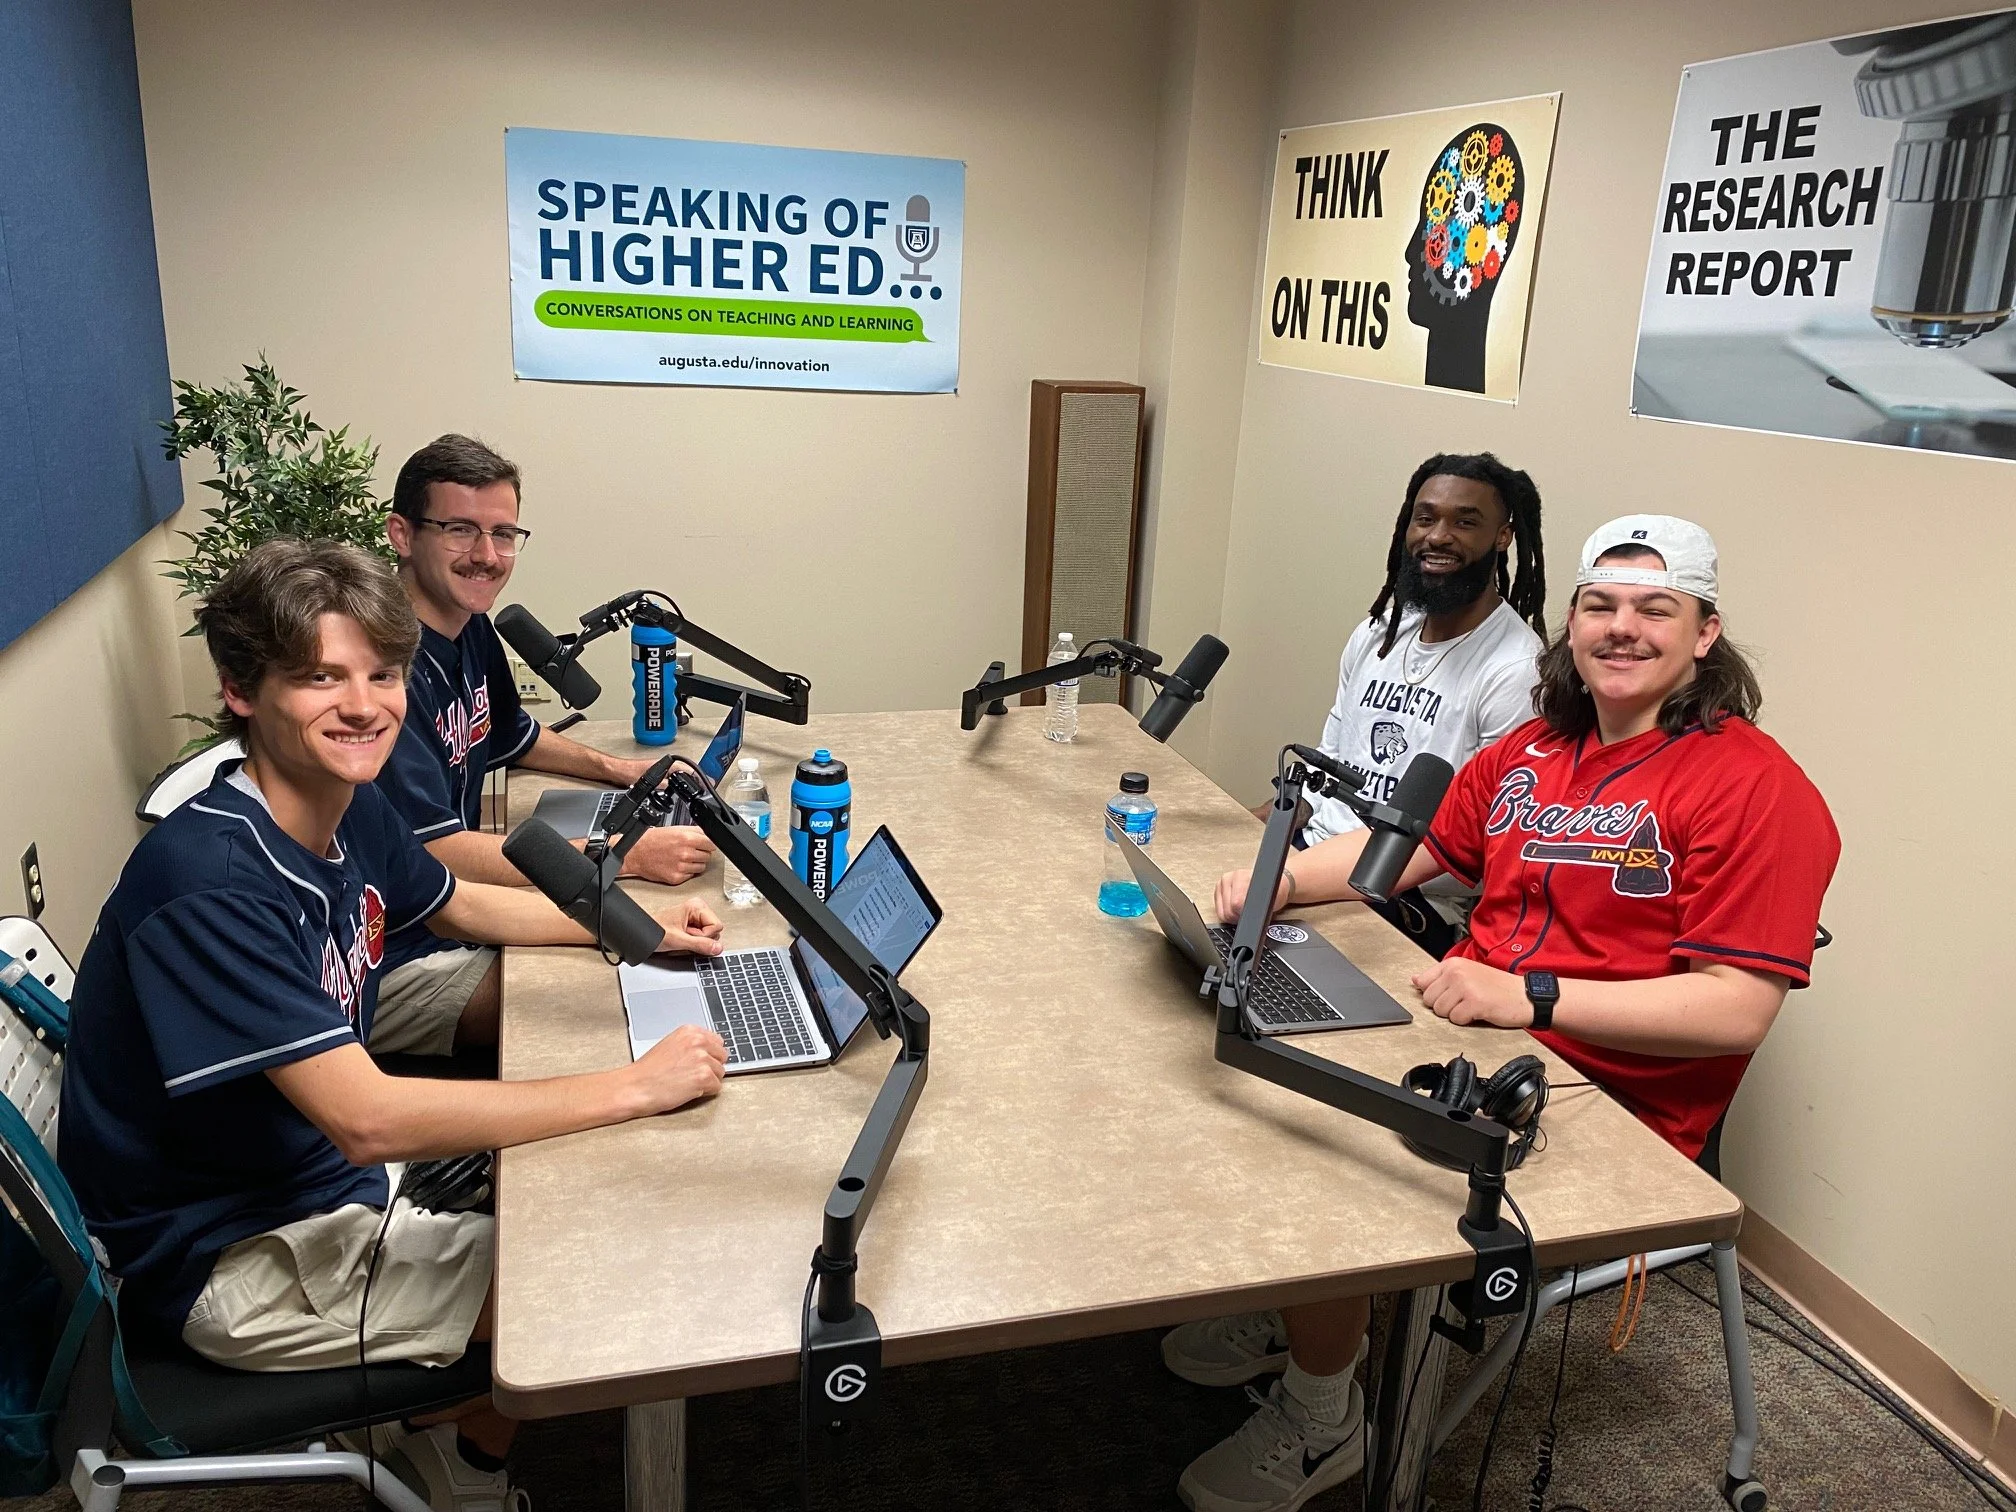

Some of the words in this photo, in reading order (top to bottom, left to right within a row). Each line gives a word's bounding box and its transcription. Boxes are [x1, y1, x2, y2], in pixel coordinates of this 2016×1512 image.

[1710, 104, 1822, 166] THE
[537, 179, 808, 236] SPEAKING
[824, 198, 890, 239] OF
[1295, 149, 1391, 220] THINK
[1662, 165, 1884, 234] RESEARCH
[539, 228, 790, 293] HIGHER
[809, 243, 943, 300] ED...
[1665, 248, 1854, 297] REPORT
[545, 302, 683, 323] CONVERSATIONS
[687, 309, 712, 323] ON
[717, 310, 797, 327] TEACHING
[801, 313, 835, 328] AND
[839, 316, 914, 332] LEARNING
[1271, 276, 1313, 340] ON
[1320, 279, 1391, 350] THIS
[658, 354, 830, 373] augusta.edu/innovation
[647, 647, 661, 728] POWERADE
[1359, 679, 1442, 727] AUGUSTA
[810, 820, 833, 828] NCAA
[1487, 767, 1648, 837] Braves
[812, 838, 827, 902] POWERA
